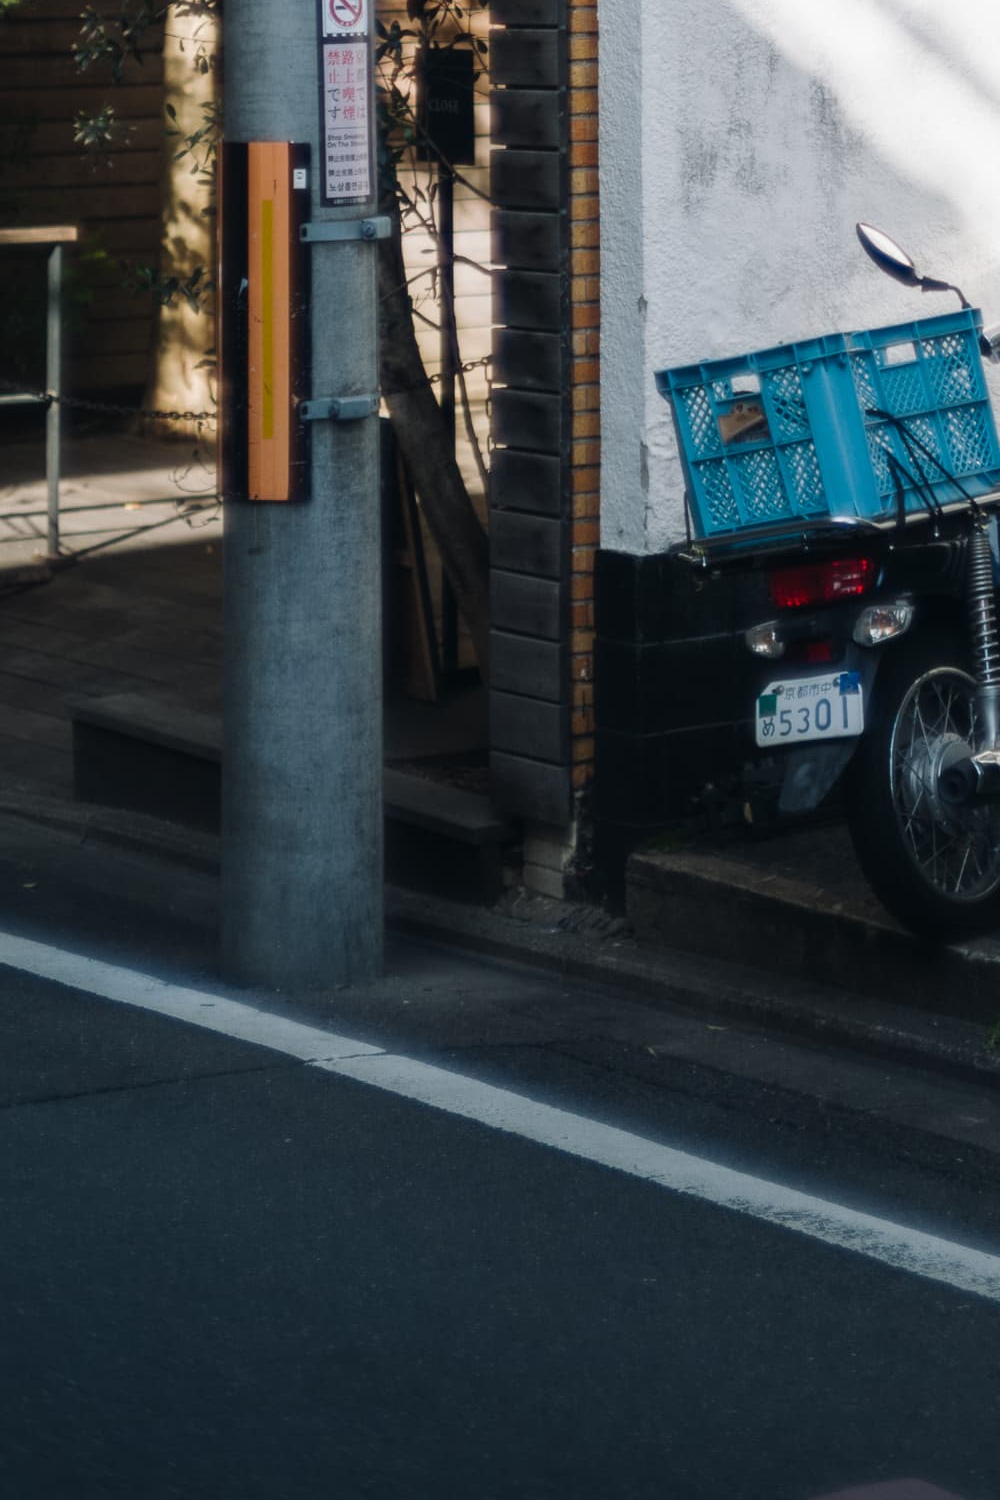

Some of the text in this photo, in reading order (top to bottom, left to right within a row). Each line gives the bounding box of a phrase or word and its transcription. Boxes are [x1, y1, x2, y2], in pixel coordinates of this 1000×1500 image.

[327, 50, 341, 121] 禁止です
[342, 50, 356, 121] 路上喫煙
[762, 696, 849, 738] め 5301
[784, 683, 832, 701] 京都市中
